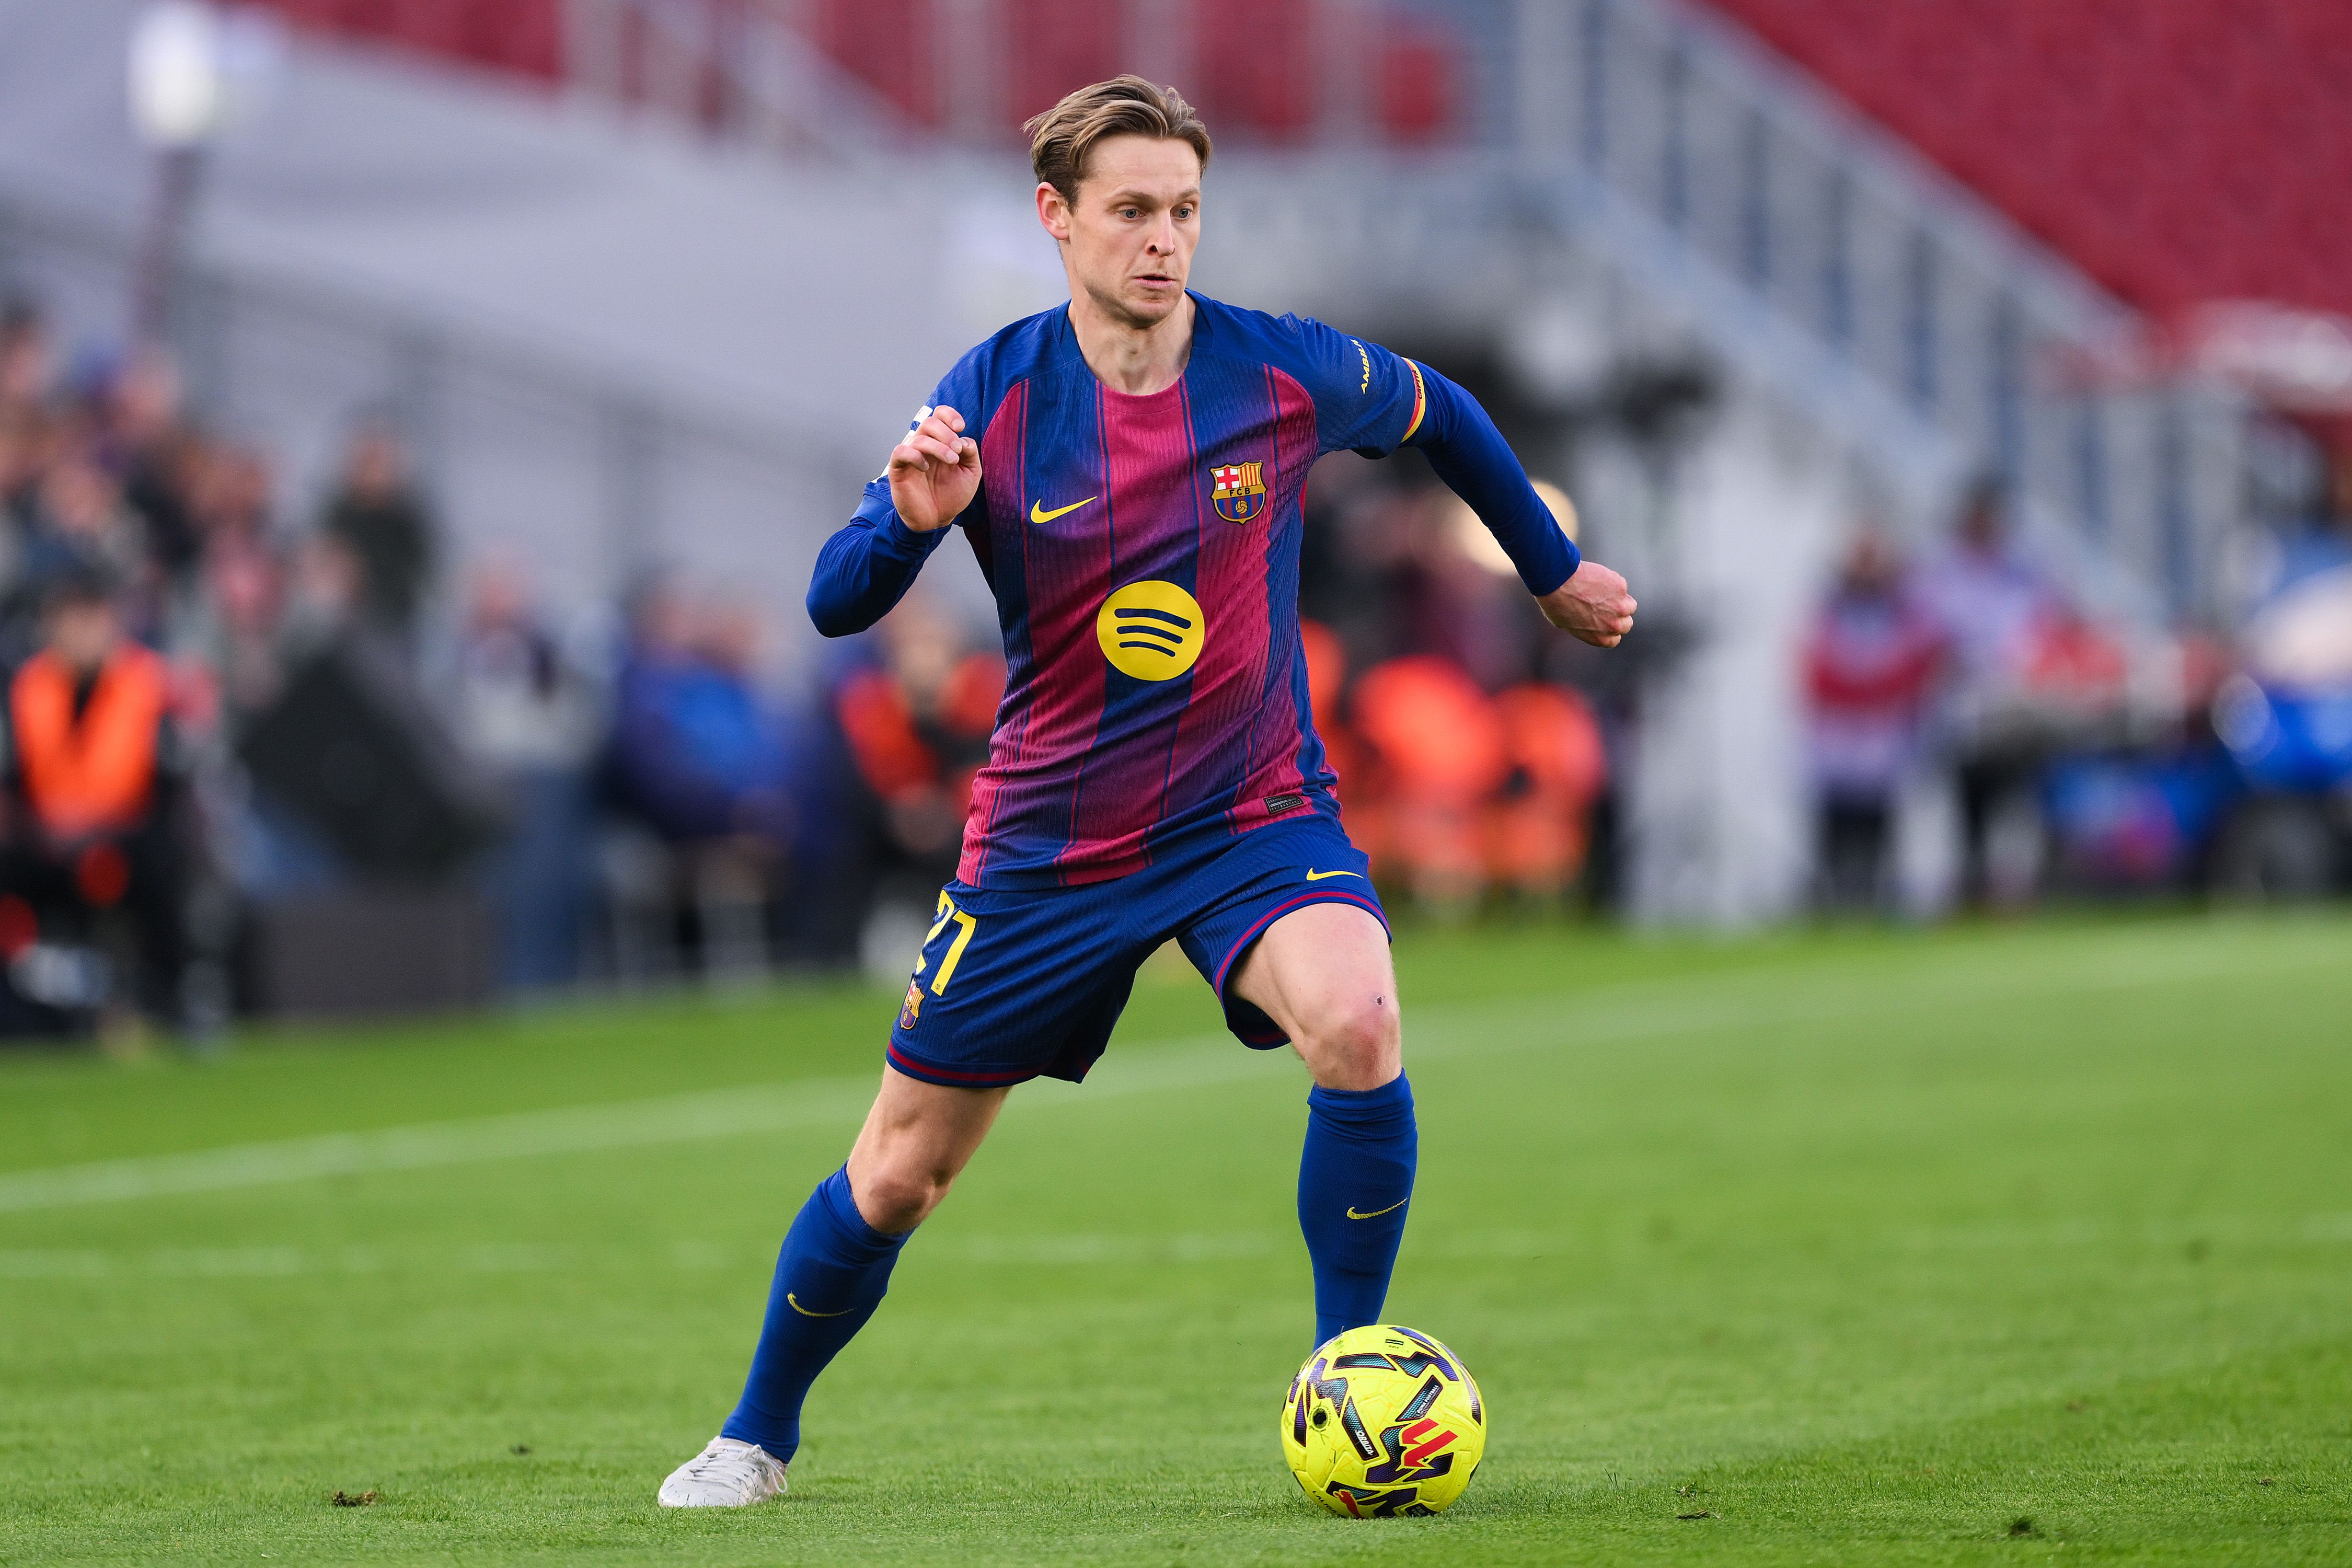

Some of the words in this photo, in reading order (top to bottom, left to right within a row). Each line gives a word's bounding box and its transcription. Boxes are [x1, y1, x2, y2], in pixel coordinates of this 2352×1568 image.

[1229, 487, 1250, 497] FCB
[916, 889, 976, 997] 27
[1424, 1385, 1439, 1402] FOOTBALL
[1355, 1430, 1374, 1456] ORBITA
